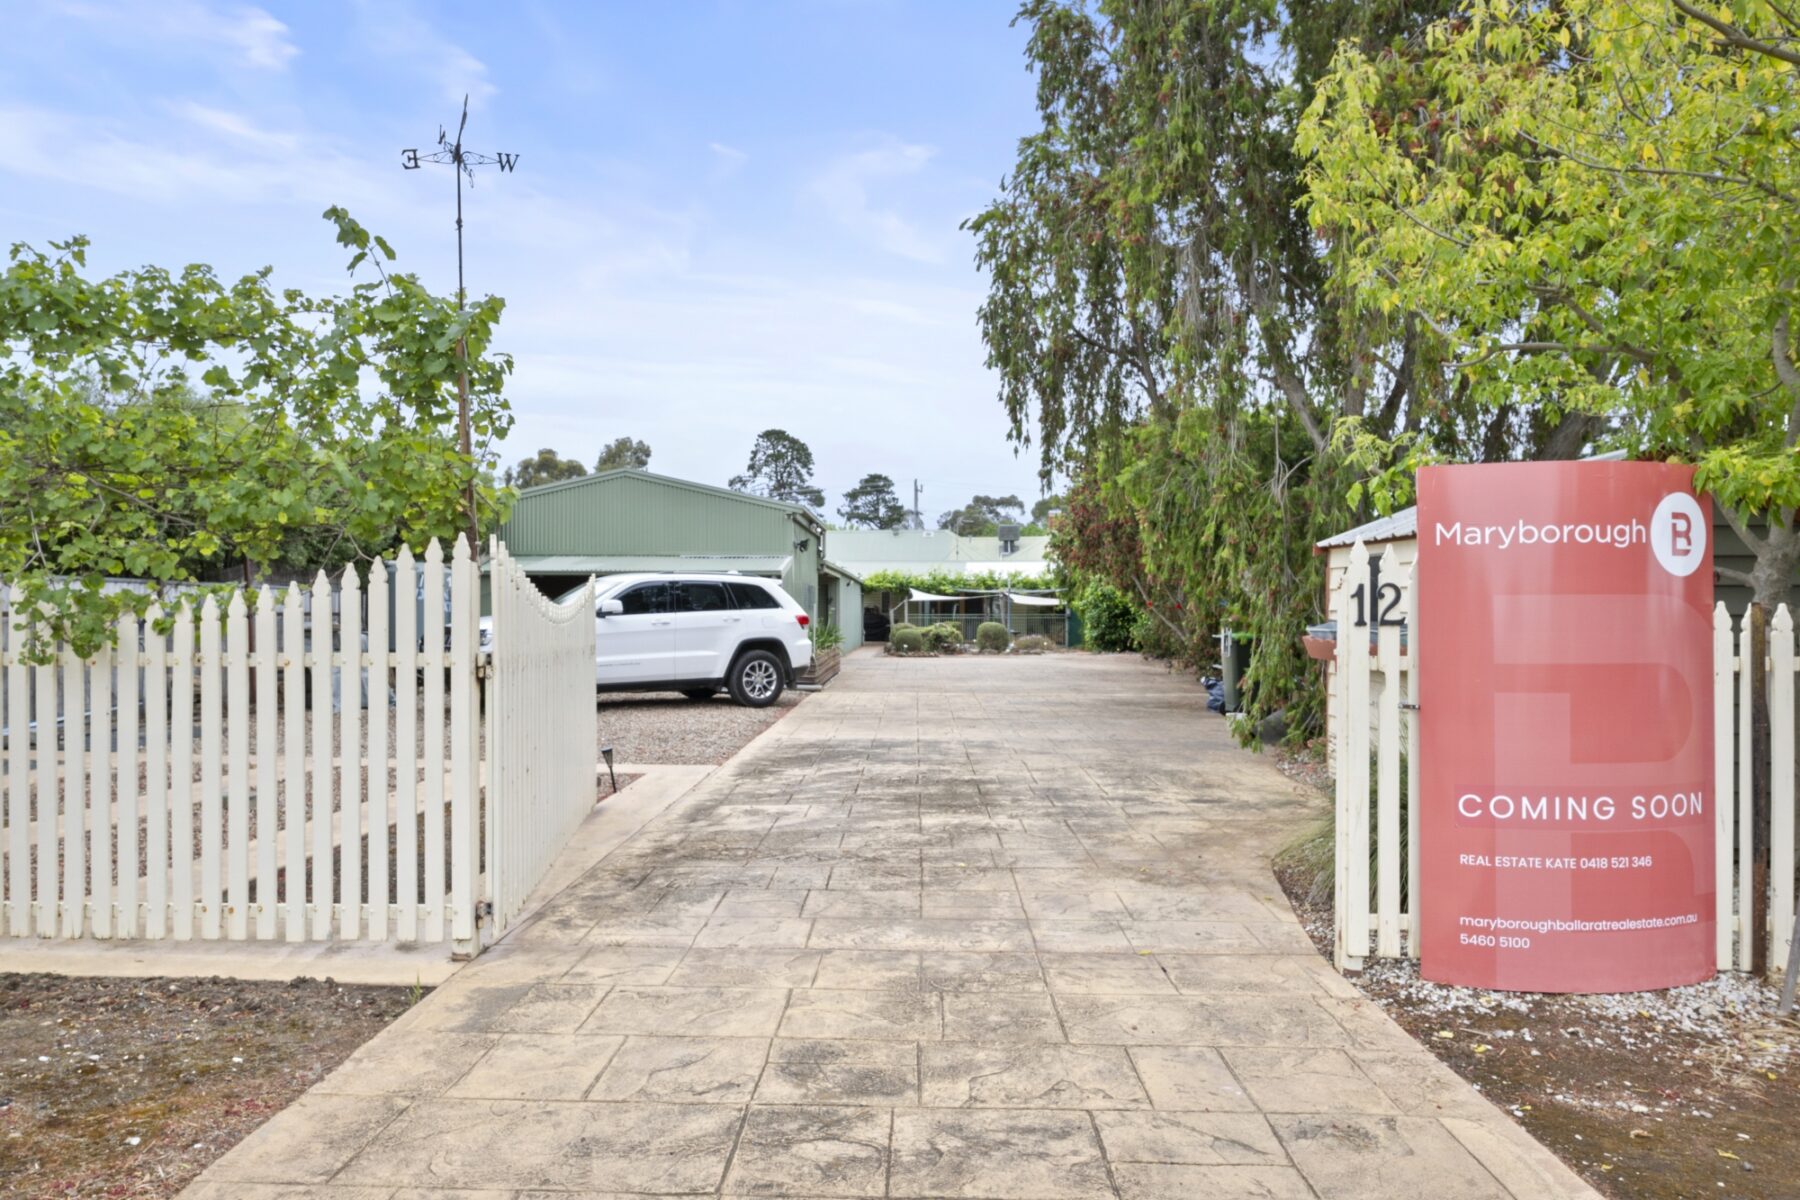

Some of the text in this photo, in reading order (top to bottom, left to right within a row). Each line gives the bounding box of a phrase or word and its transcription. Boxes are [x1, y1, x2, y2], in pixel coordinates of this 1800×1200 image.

[496, 152, 520, 173] W
[1435, 518, 1646, 549] Maryborough
[1350, 582, 1407, 627] 12
[1458, 791, 1702, 820] COMING SOON
[1460, 854, 1652, 869] REAL ESTATE KATE 0418 521 346
[1460, 913, 1698, 933] maryboroughballaratrealestate.com.au
[1460, 934, 1530, 949] 5460 5100
